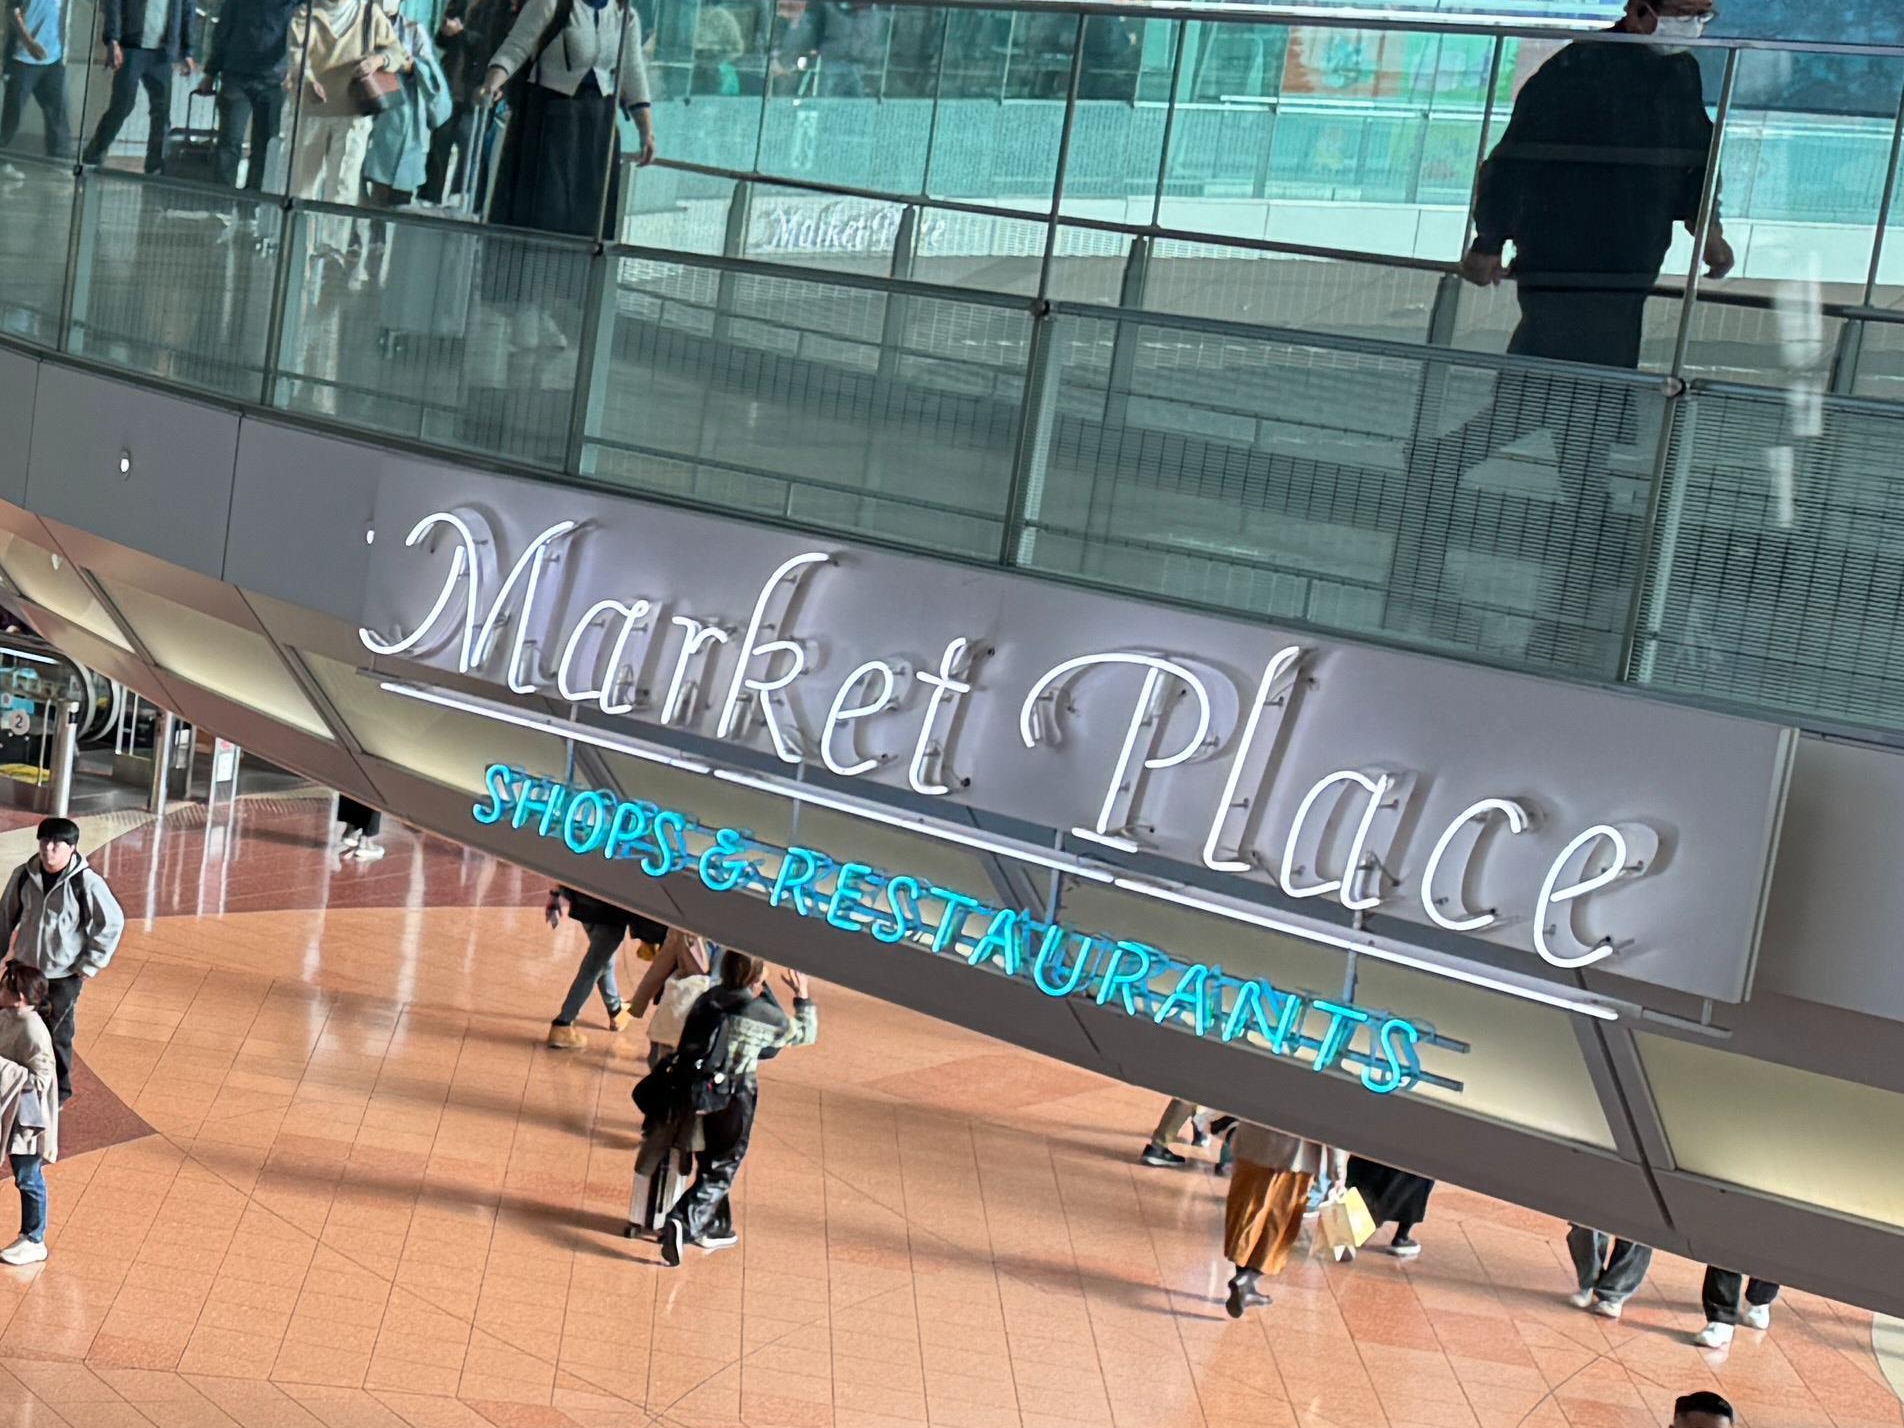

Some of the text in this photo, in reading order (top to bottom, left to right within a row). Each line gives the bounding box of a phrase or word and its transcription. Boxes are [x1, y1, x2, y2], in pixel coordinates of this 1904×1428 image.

[13, 715, 25, 729] 2
[357, 510, 1637, 970] Market Place
[473, 762, 1427, 1096] SHOPS & RESTAURANTS
